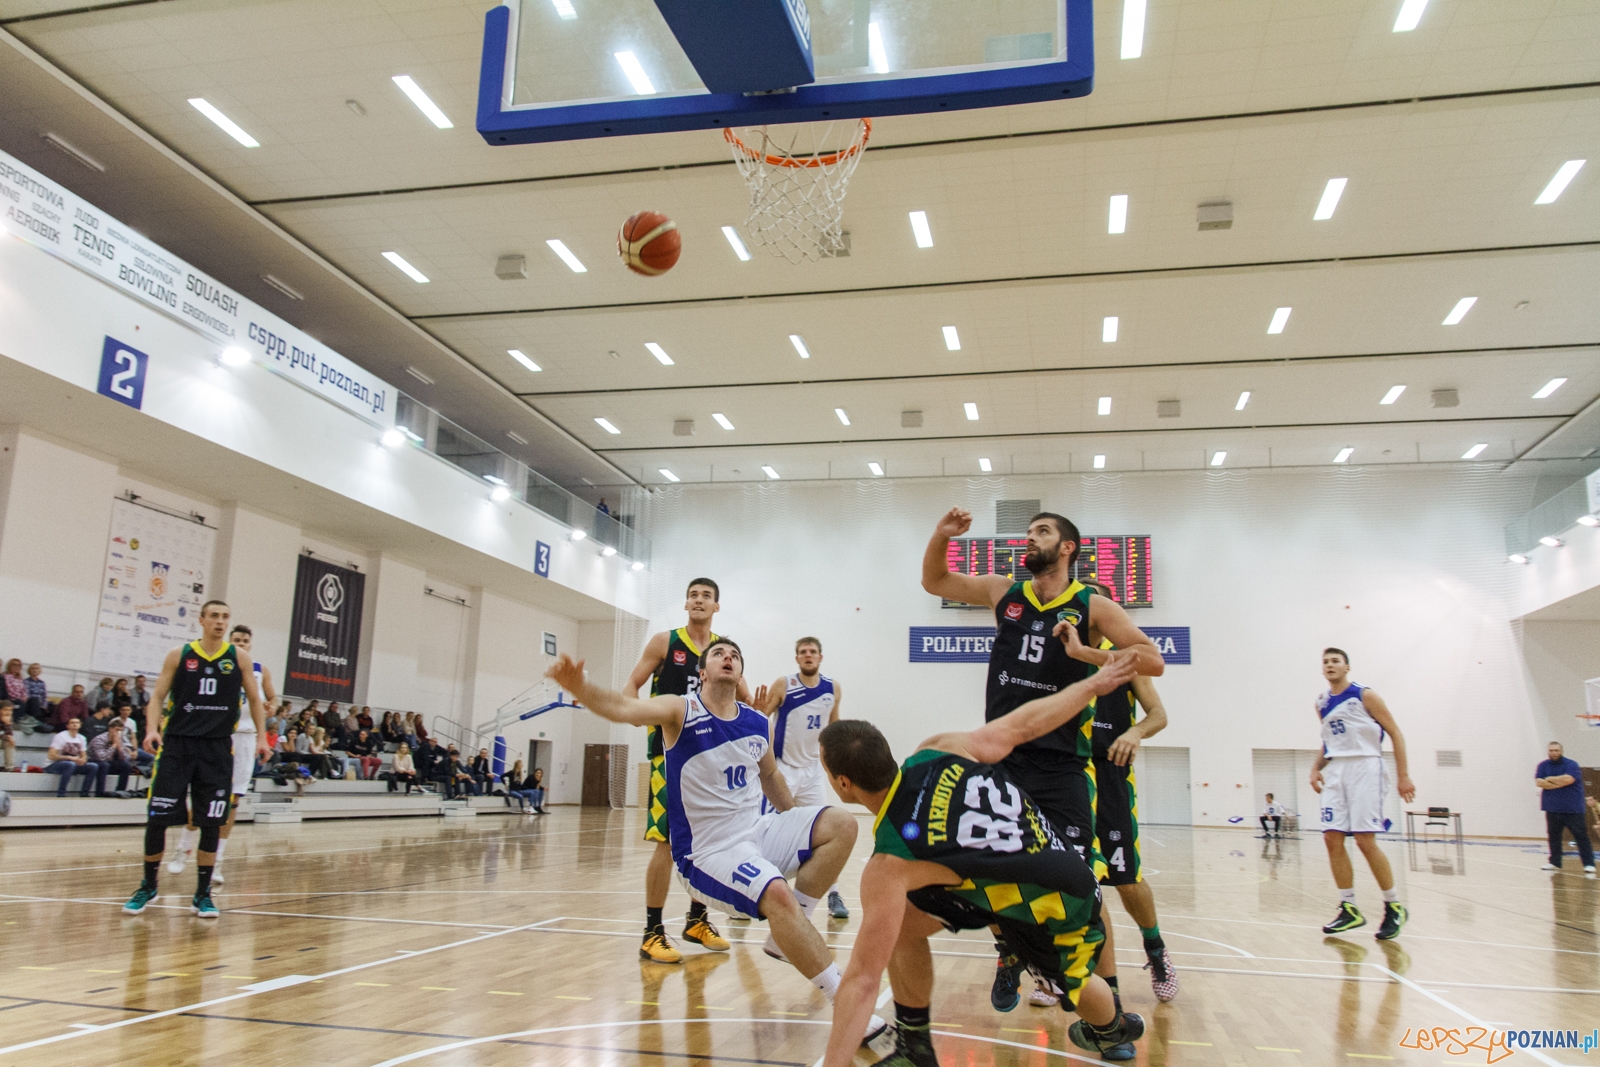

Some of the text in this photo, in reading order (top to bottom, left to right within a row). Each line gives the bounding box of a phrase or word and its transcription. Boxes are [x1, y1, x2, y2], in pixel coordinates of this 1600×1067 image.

[6, 205, 61, 245] AEROBIK
[74, 207, 99, 230] JUDO
[73, 223, 116, 260] TENIS
[118, 263, 178, 308] BOWLING
[185, 273, 239, 317] SQUASH
[110, 348, 138, 400] 2
[248, 321, 386, 413] cspp.put.poznan.pl
[538, 545, 549, 573] 3
[922, 636, 1177, 653] POLITEC KA
[1017, 633, 1046, 664] 15
[198, 677, 217, 695] 10
[806, 714, 821, 730] 24
[1329, 719, 1346, 735] 55
[723, 764, 747, 791] 10
[207, 800, 226, 818] 10
[957, 774, 1023, 853] 82
[1109, 846, 1126, 872] 4
[732, 861, 761, 888] 10
